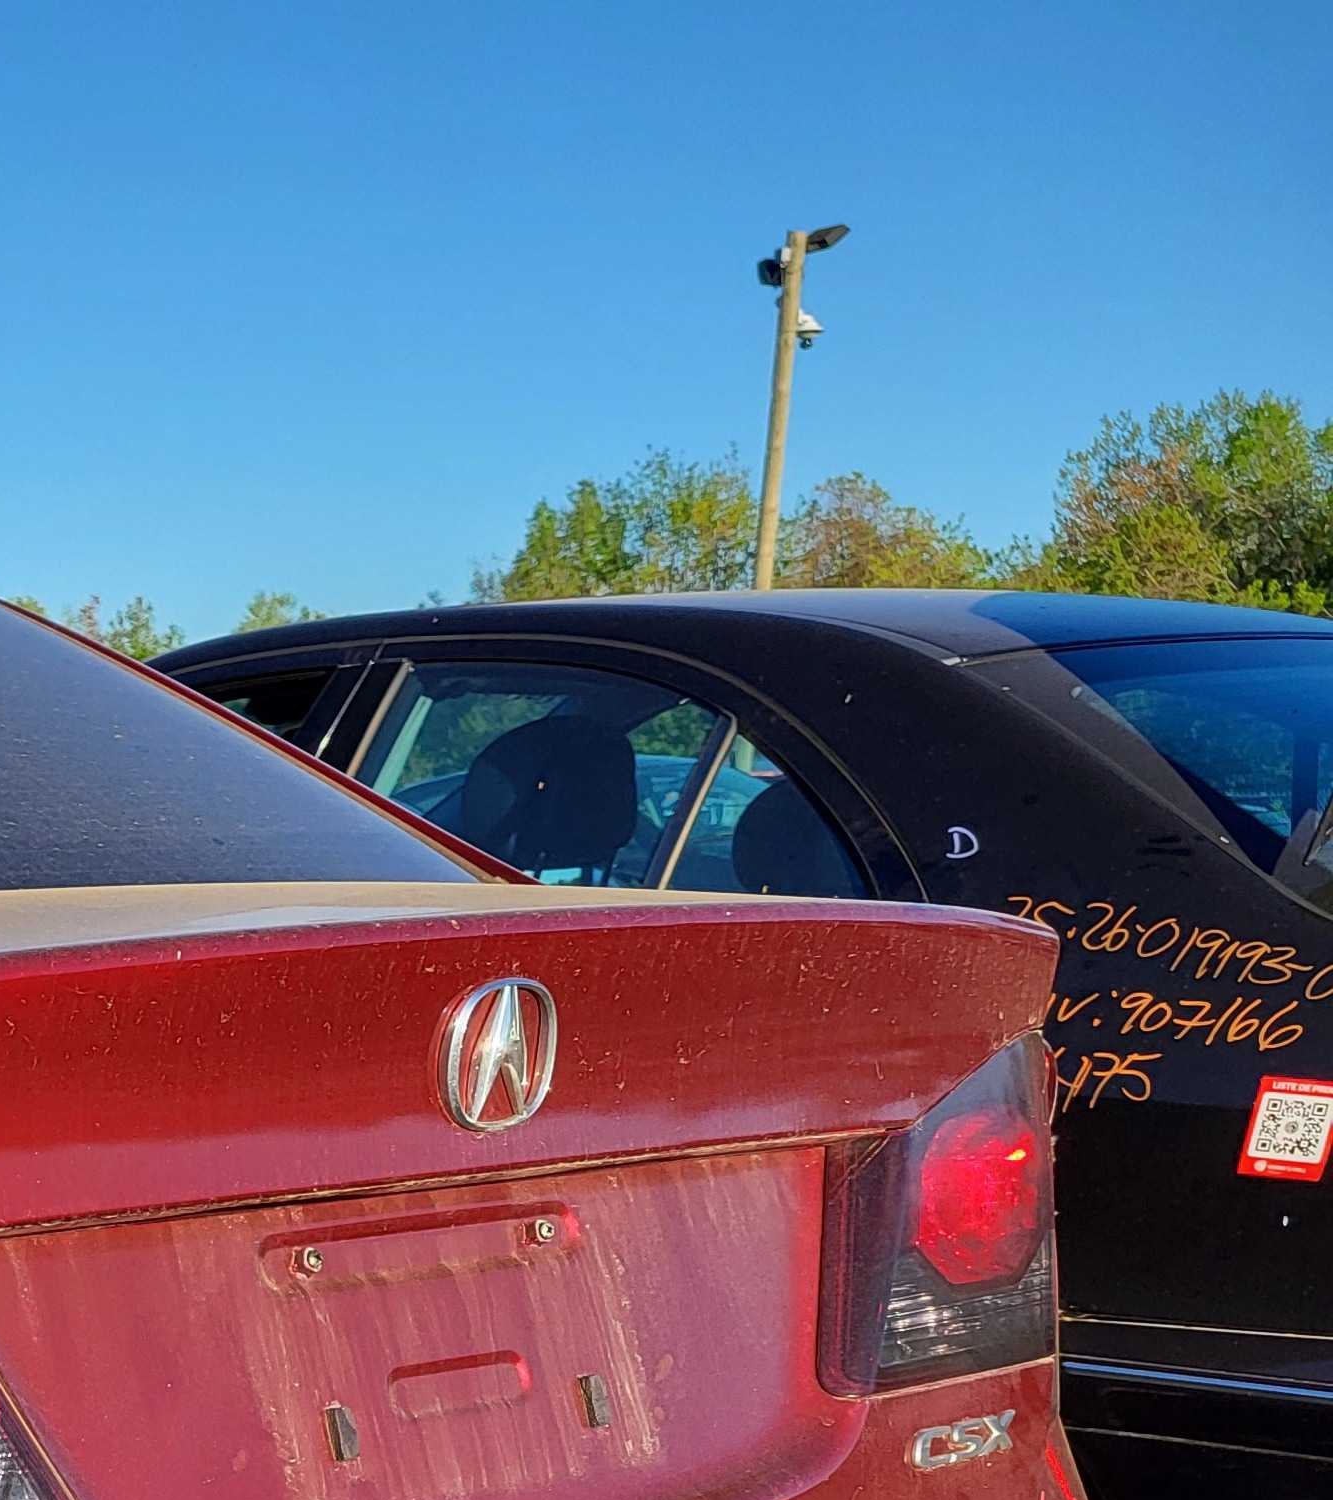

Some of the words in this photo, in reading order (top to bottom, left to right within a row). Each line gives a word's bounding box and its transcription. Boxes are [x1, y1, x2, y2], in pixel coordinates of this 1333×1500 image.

[946, 826, 980, 859] D
[1120, 992, 1303, 1051] 907166
[906, 1408, 1017, 1472] CSX
